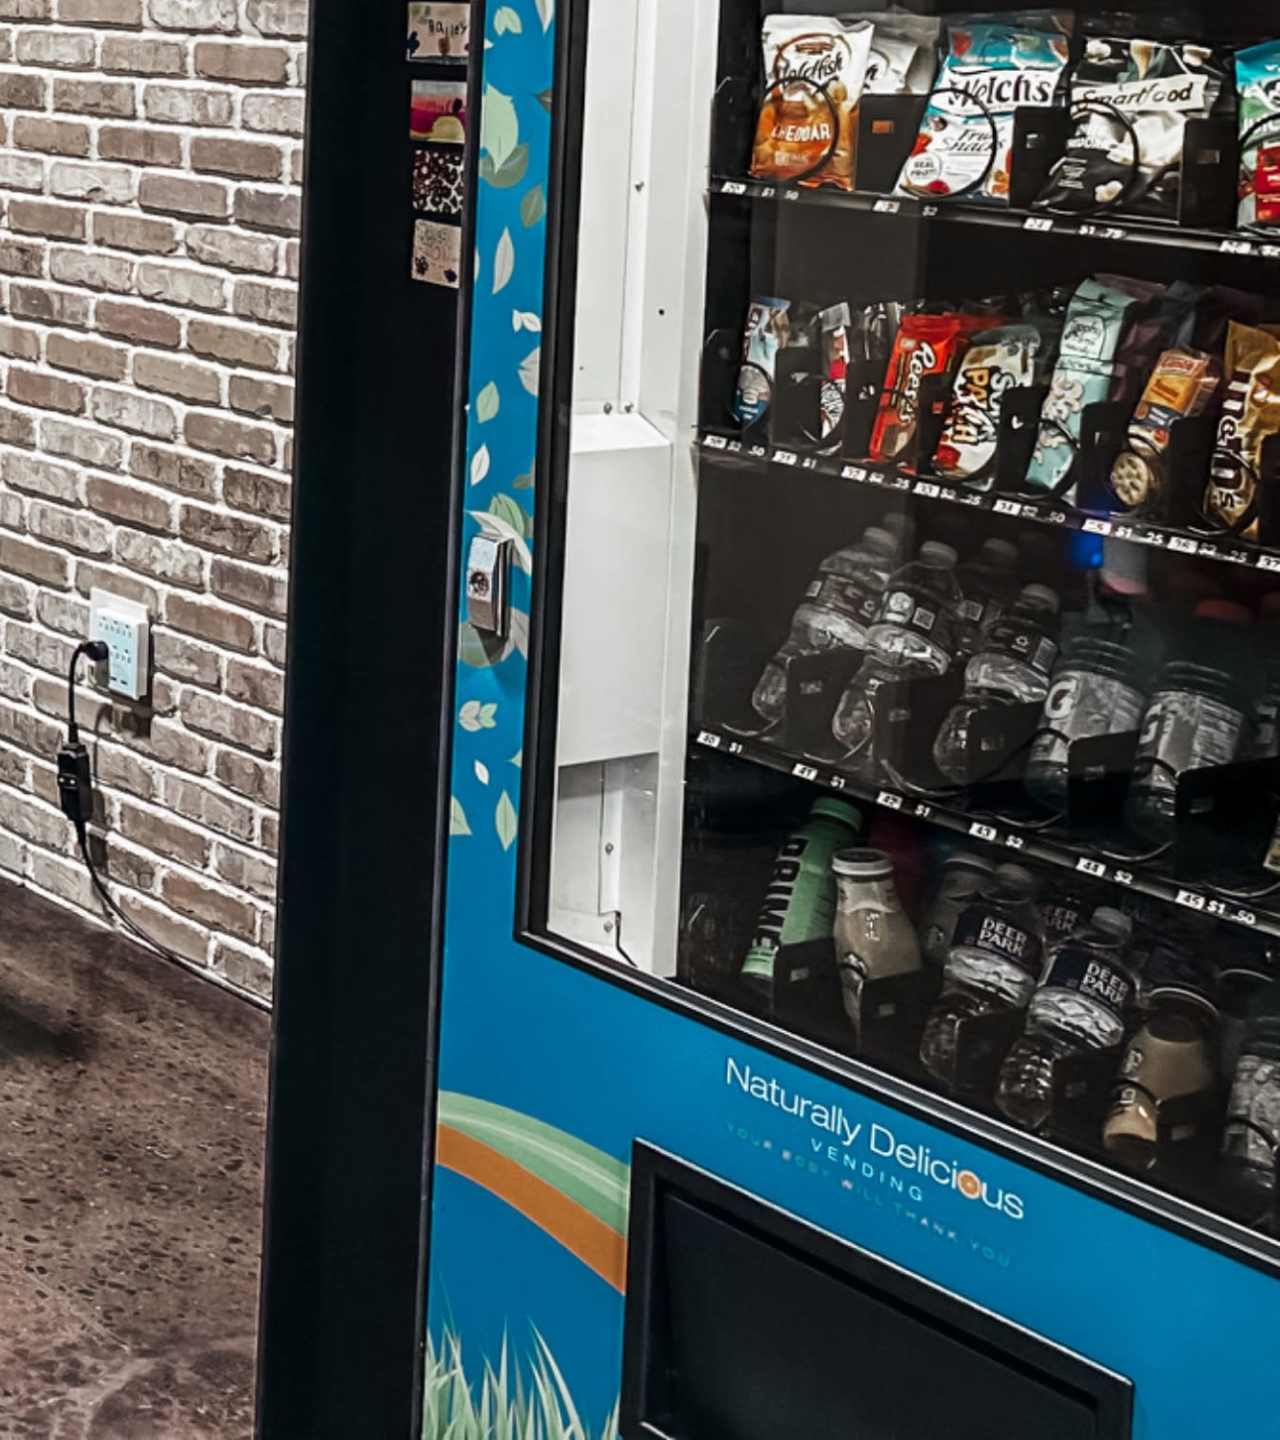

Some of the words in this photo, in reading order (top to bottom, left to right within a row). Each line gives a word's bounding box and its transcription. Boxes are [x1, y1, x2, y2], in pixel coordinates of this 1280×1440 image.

[729, 742, 743, 754] $1
[914, 805, 931, 818] $1
[1005, 835, 1023, 849] $2
[1114, 869, 1133, 885] $2
[1206, 900, 1226, 914] $1
[979, 928, 1024, 958] PARK
[982, 916, 1028, 945] DEER
[1082, 974, 1128, 1004] PARK
[1087, 962, 1130, 992] DEER
[726, 1057, 861, 1146] Naturally
[869, 1123, 1024, 1220] Delicious
[810, 1137, 923, 1202] VENDING
